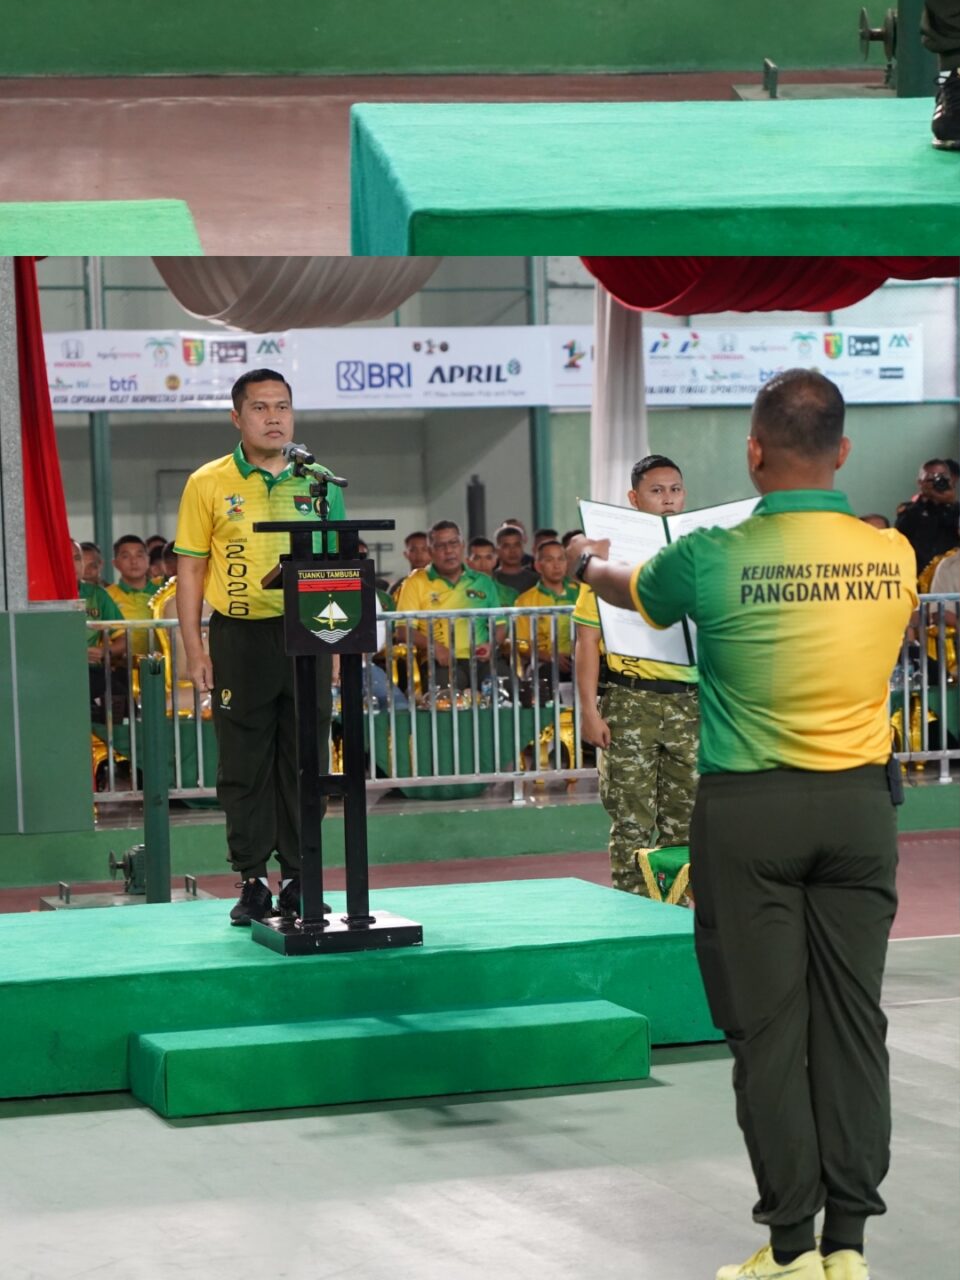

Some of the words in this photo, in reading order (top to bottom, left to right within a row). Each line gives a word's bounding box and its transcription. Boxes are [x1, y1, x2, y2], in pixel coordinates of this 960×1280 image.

[109, 375, 138, 392] btn
[368, 362, 413, 388] BRI
[427, 365, 508, 384] APRIL
[226, 544, 250, 616] 2026
[299, 571, 326, 579] TUANKU
[326, 570, 360, 578] TAMBUSAI
[741, 564, 813, 581] KEJURNAS
[816, 563, 864, 579] TENNIS
[867, 562, 901, 577] PIALA
[740, 582, 840, 605] PANGDAM
[845, 580, 901, 601] XIX/TT
